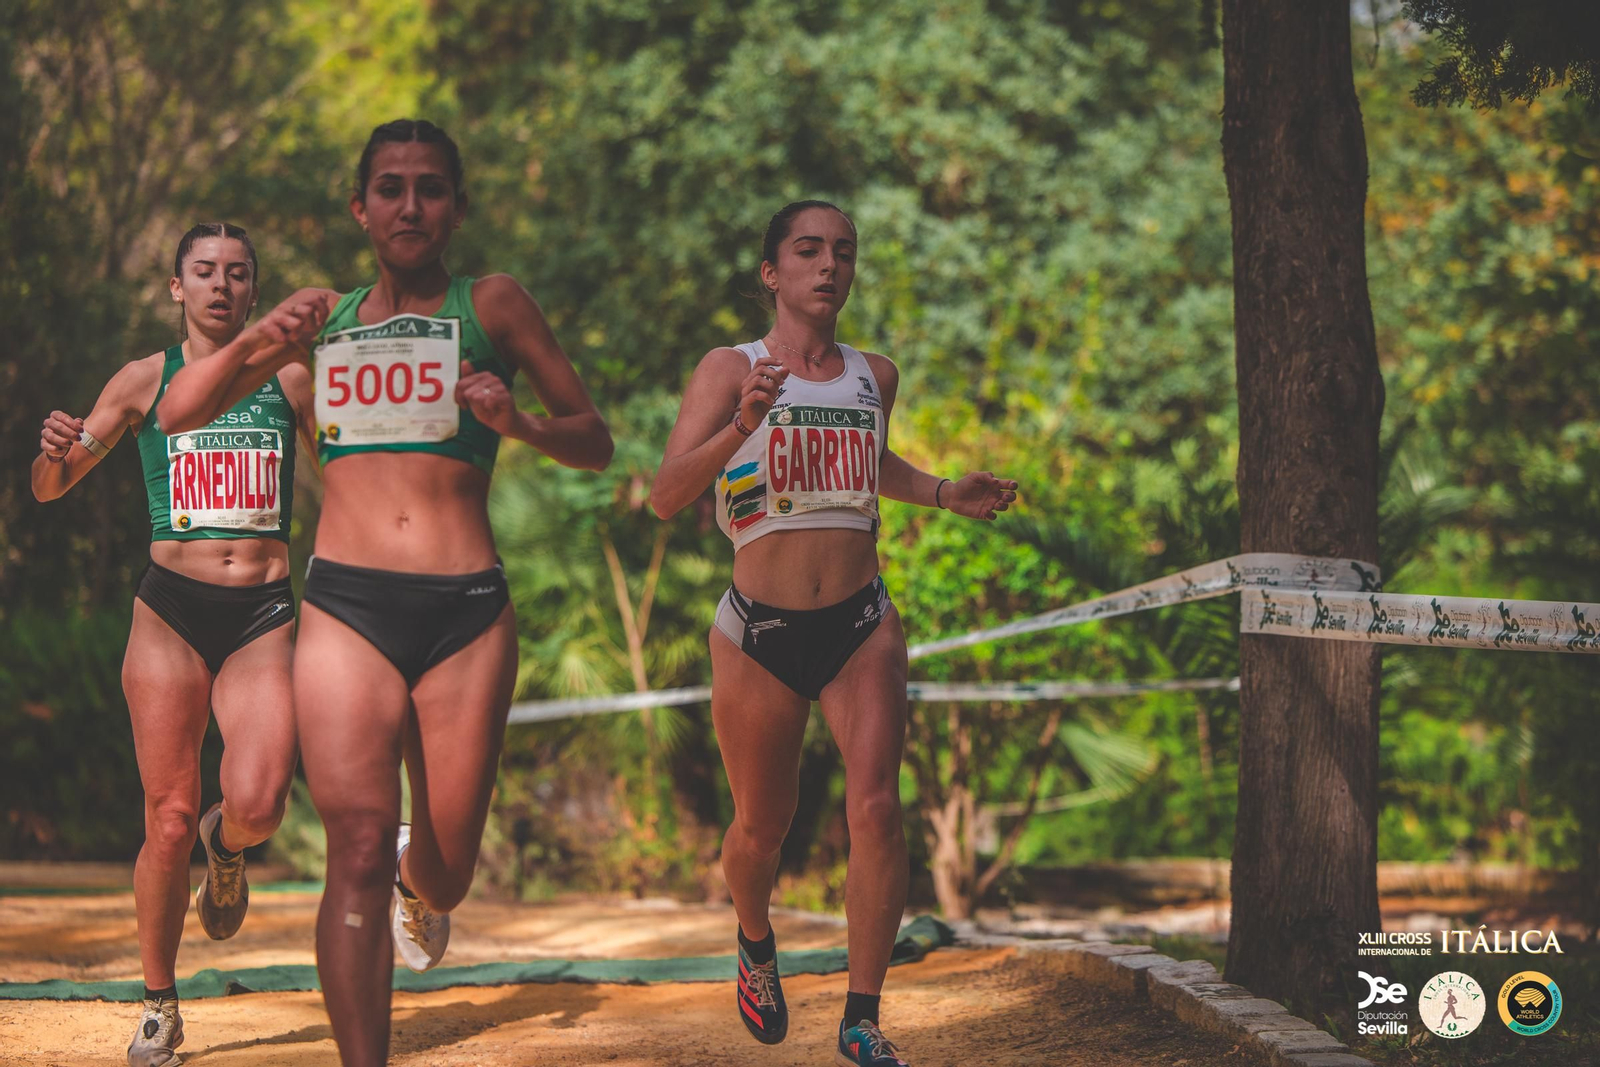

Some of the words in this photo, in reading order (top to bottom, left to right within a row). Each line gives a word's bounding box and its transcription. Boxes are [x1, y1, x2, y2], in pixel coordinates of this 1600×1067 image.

[327, 362, 444, 408] 5005
[210, 412, 254, 424] csa
[800, 408, 852, 424] ITÁLICA
[200, 433, 252, 446] ITÁLICA
[768, 427, 876, 494] GARRIDO
[173, 451, 276, 510] ARNEDILLO
[1385, 620, 1405, 635] Sevilla
[1447, 624, 1470, 640] Sevilla
